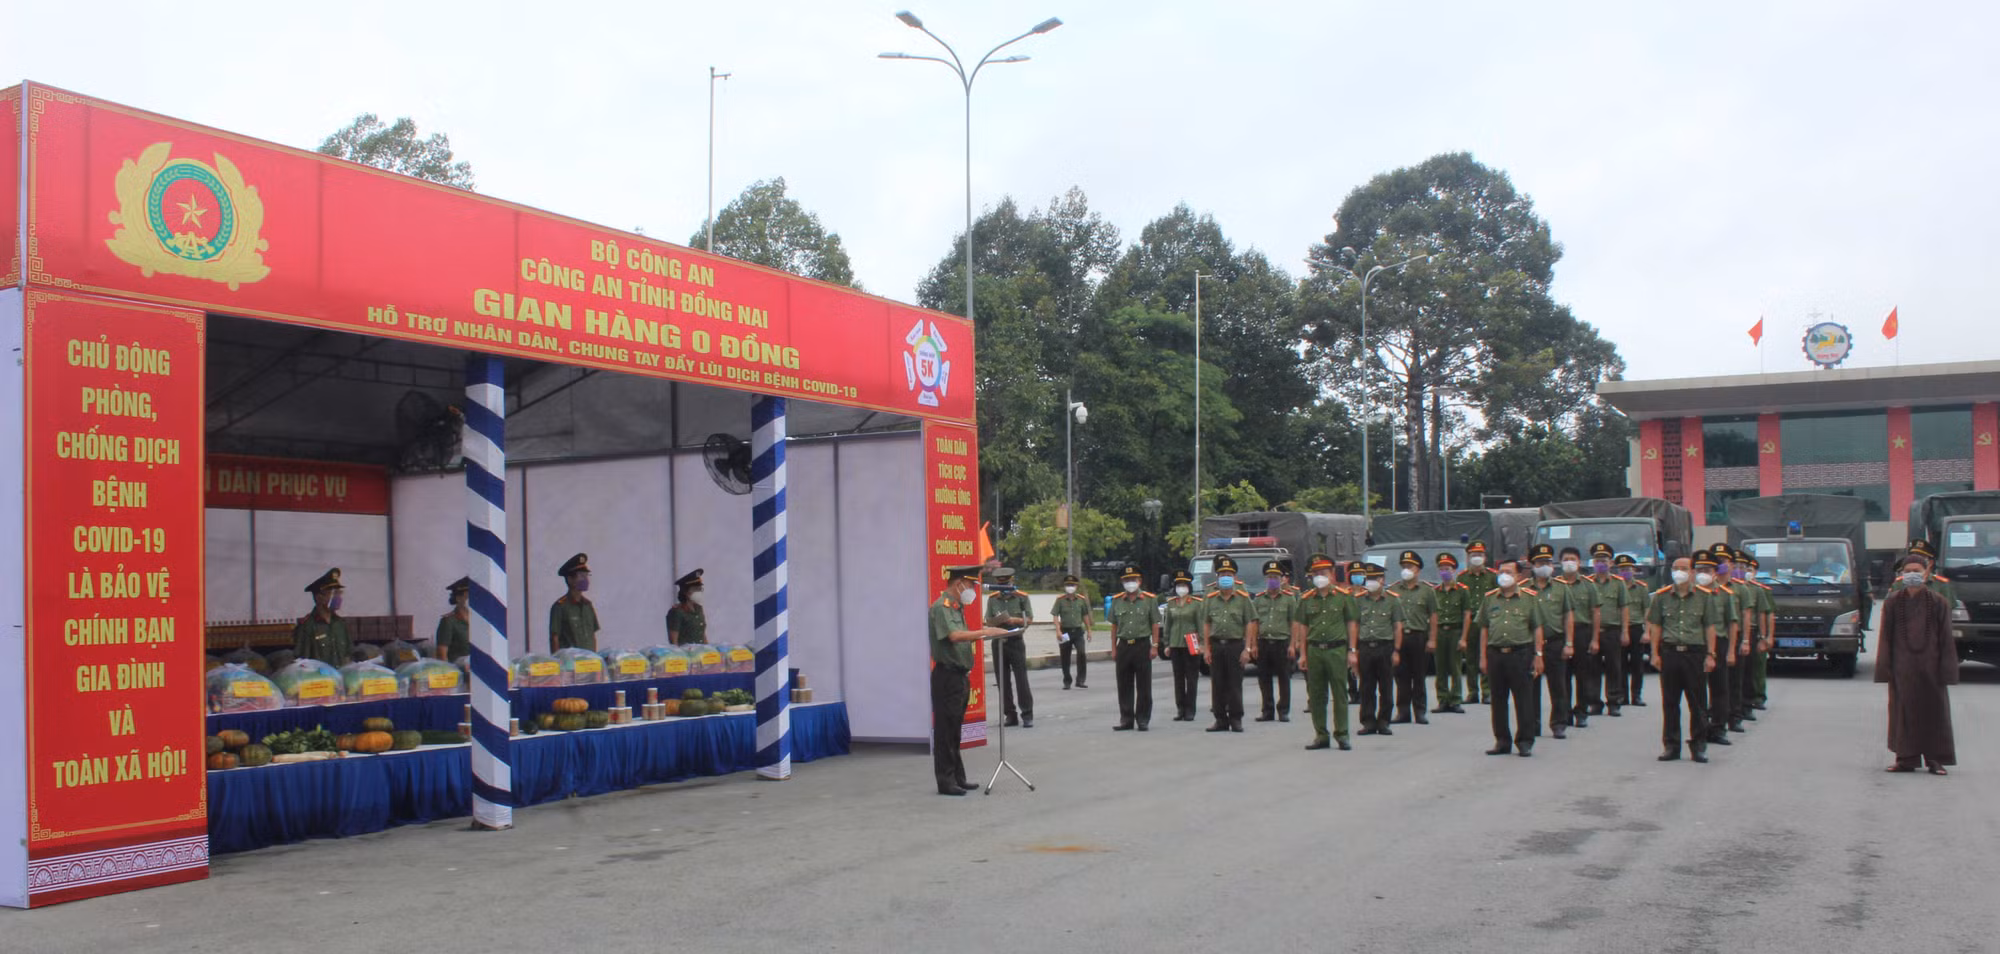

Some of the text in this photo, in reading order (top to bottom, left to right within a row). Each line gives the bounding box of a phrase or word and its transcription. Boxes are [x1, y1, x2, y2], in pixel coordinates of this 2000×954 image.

[591, 239, 715, 288] BỘ CÔNG AN
[520, 257, 769, 329] CÔNG AN TỈNH ĐỒNG NAI
[473, 287, 572, 331] GIAN
[585, 308, 682, 350] HÀNG
[720, 332, 800, 370] ĐỒNG
[67, 334, 171, 378] CHỦ ĐỘNG
[367, 303, 858, 399] HỖ TRỢ NHÂN DÂN, CHUNG TAY ĐẨY LÙI DỊCH BỆNH COVID-19
[921, 359, 934, 378] 5K
[81, 383, 158, 422] PHÒNG,
[56, 424, 180, 469] CHỐNG DỊCH
[92, 474, 147, 513] BỆNH
[267, 472, 319, 501] PHỤC
[324, 475, 348, 502] VỤ
[73, 525, 166, 554] COVID-19
[68, 563, 171, 604] LÀ BẢO VỆ
[64, 612, 175, 649] CHÍNH BẠN
[76, 657, 166, 693] GIA ĐÌNH
[108, 703, 136, 737] VÀ
[53, 745, 188, 789] TOÀN XÃ HỘI!
